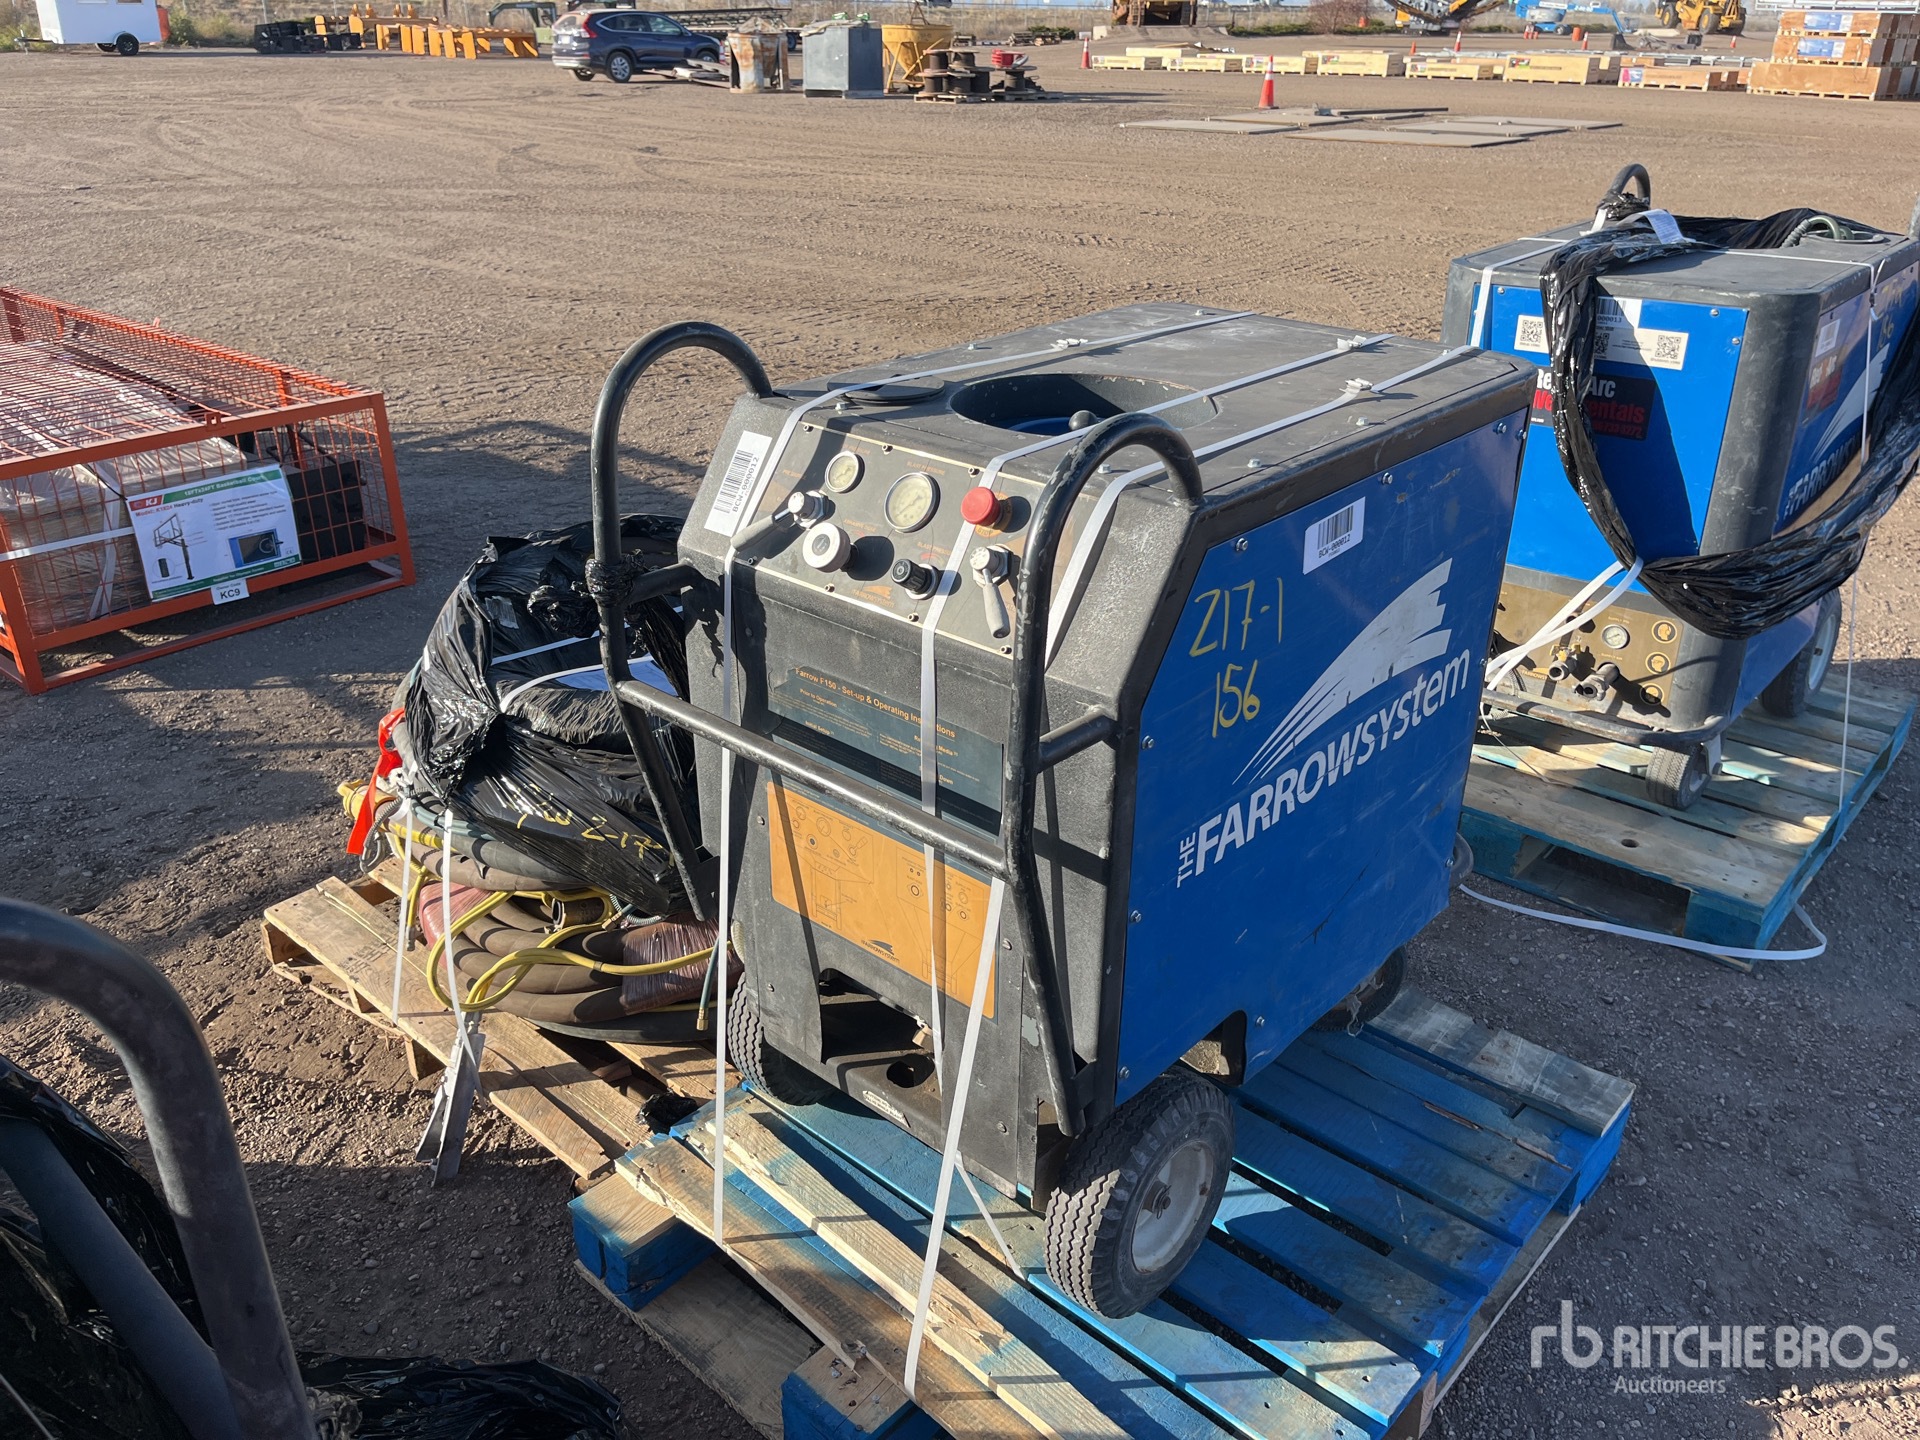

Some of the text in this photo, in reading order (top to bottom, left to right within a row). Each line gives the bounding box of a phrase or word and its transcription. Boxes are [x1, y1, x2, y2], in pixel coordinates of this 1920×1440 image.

[1590, 401, 1645, 424] entals
[146, 497, 158, 506] KJ
[732, 456, 760, 512] BCW-000012
[1318, 534, 1350, 558] BCW-000012
[220, 588, 240, 600] KC9
[795, 666, 819, 683] Farrow
[820, 676, 836, 690] F150
[842, 685, 865, 702] Set-up
[866, 694, 873, 704] &
[873, 697, 910, 720] Operating
[910, 711, 956, 740] Instions
[1212, 659, 1260, 739] 156
[1176, 831, 1197, 888] THE
